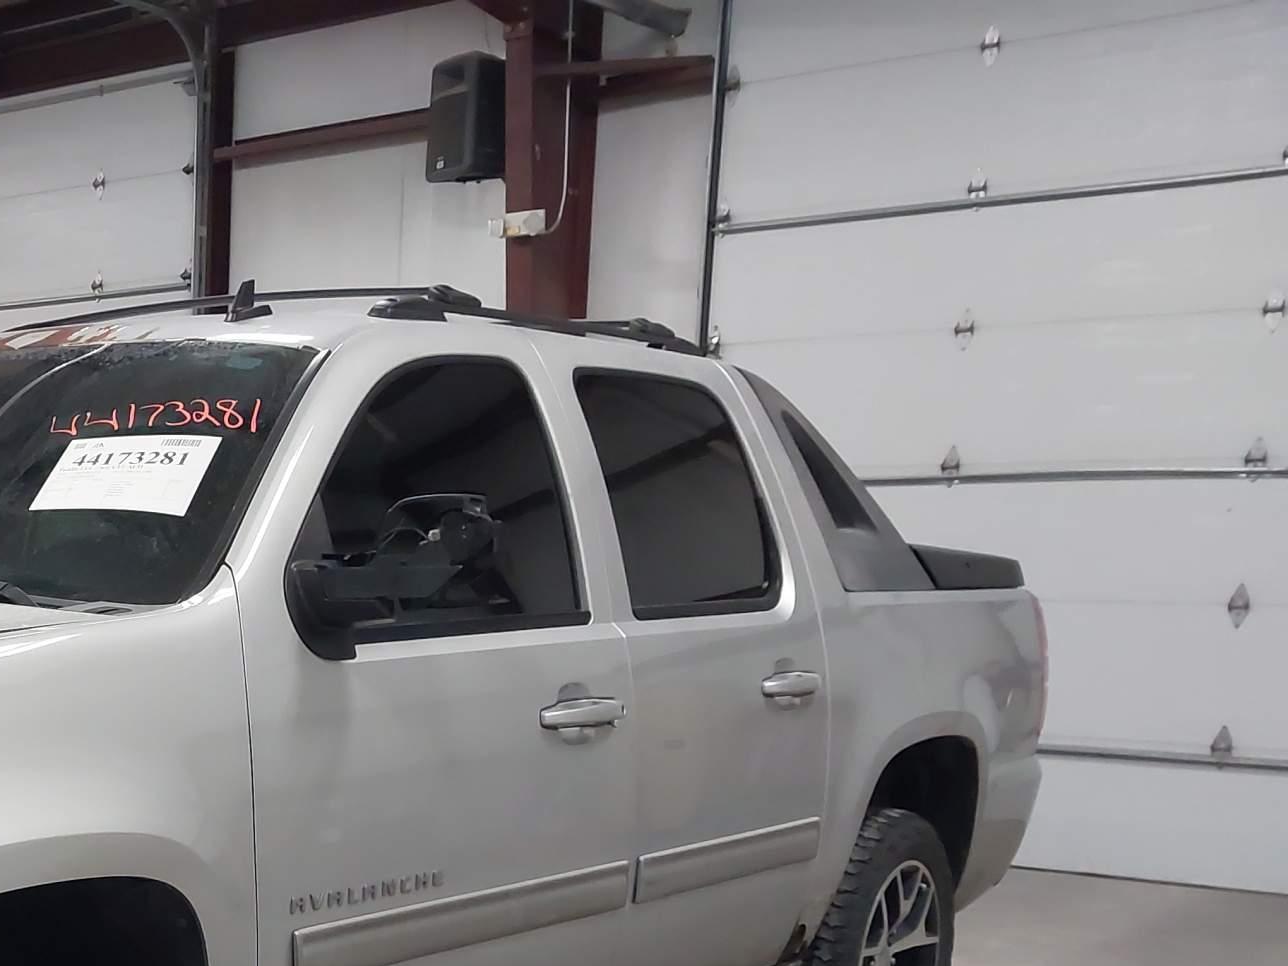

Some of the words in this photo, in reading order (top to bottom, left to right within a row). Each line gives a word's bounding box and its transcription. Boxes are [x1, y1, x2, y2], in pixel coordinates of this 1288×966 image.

[50, 397, 262, 437] 44173281
[72, 450, 190, 467] 44173281
[288, 869, 446, 915] AVALANCHE
